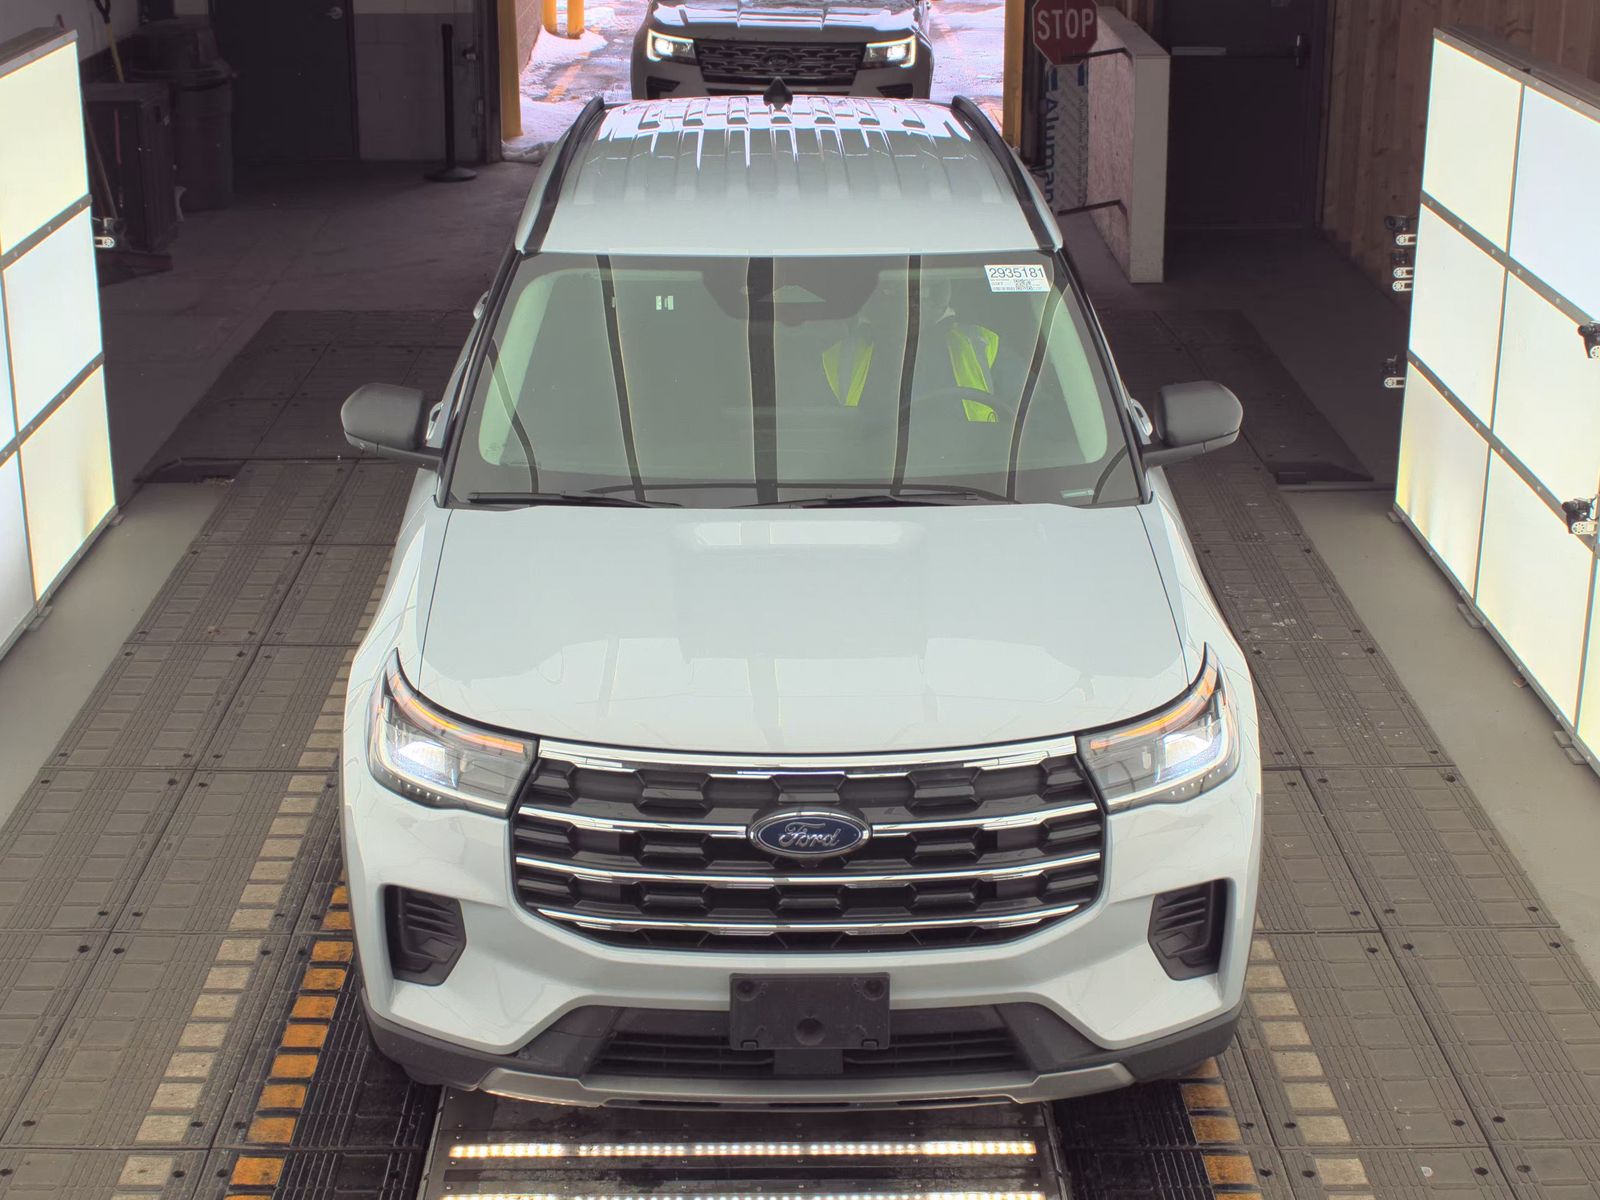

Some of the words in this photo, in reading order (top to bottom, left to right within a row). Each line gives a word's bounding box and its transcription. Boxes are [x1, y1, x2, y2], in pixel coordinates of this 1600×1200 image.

[1037, 8, 1094, 40] STOP
[989, 267, 1044, 278] 2935181
[778, 821, 842, 848] Ford
